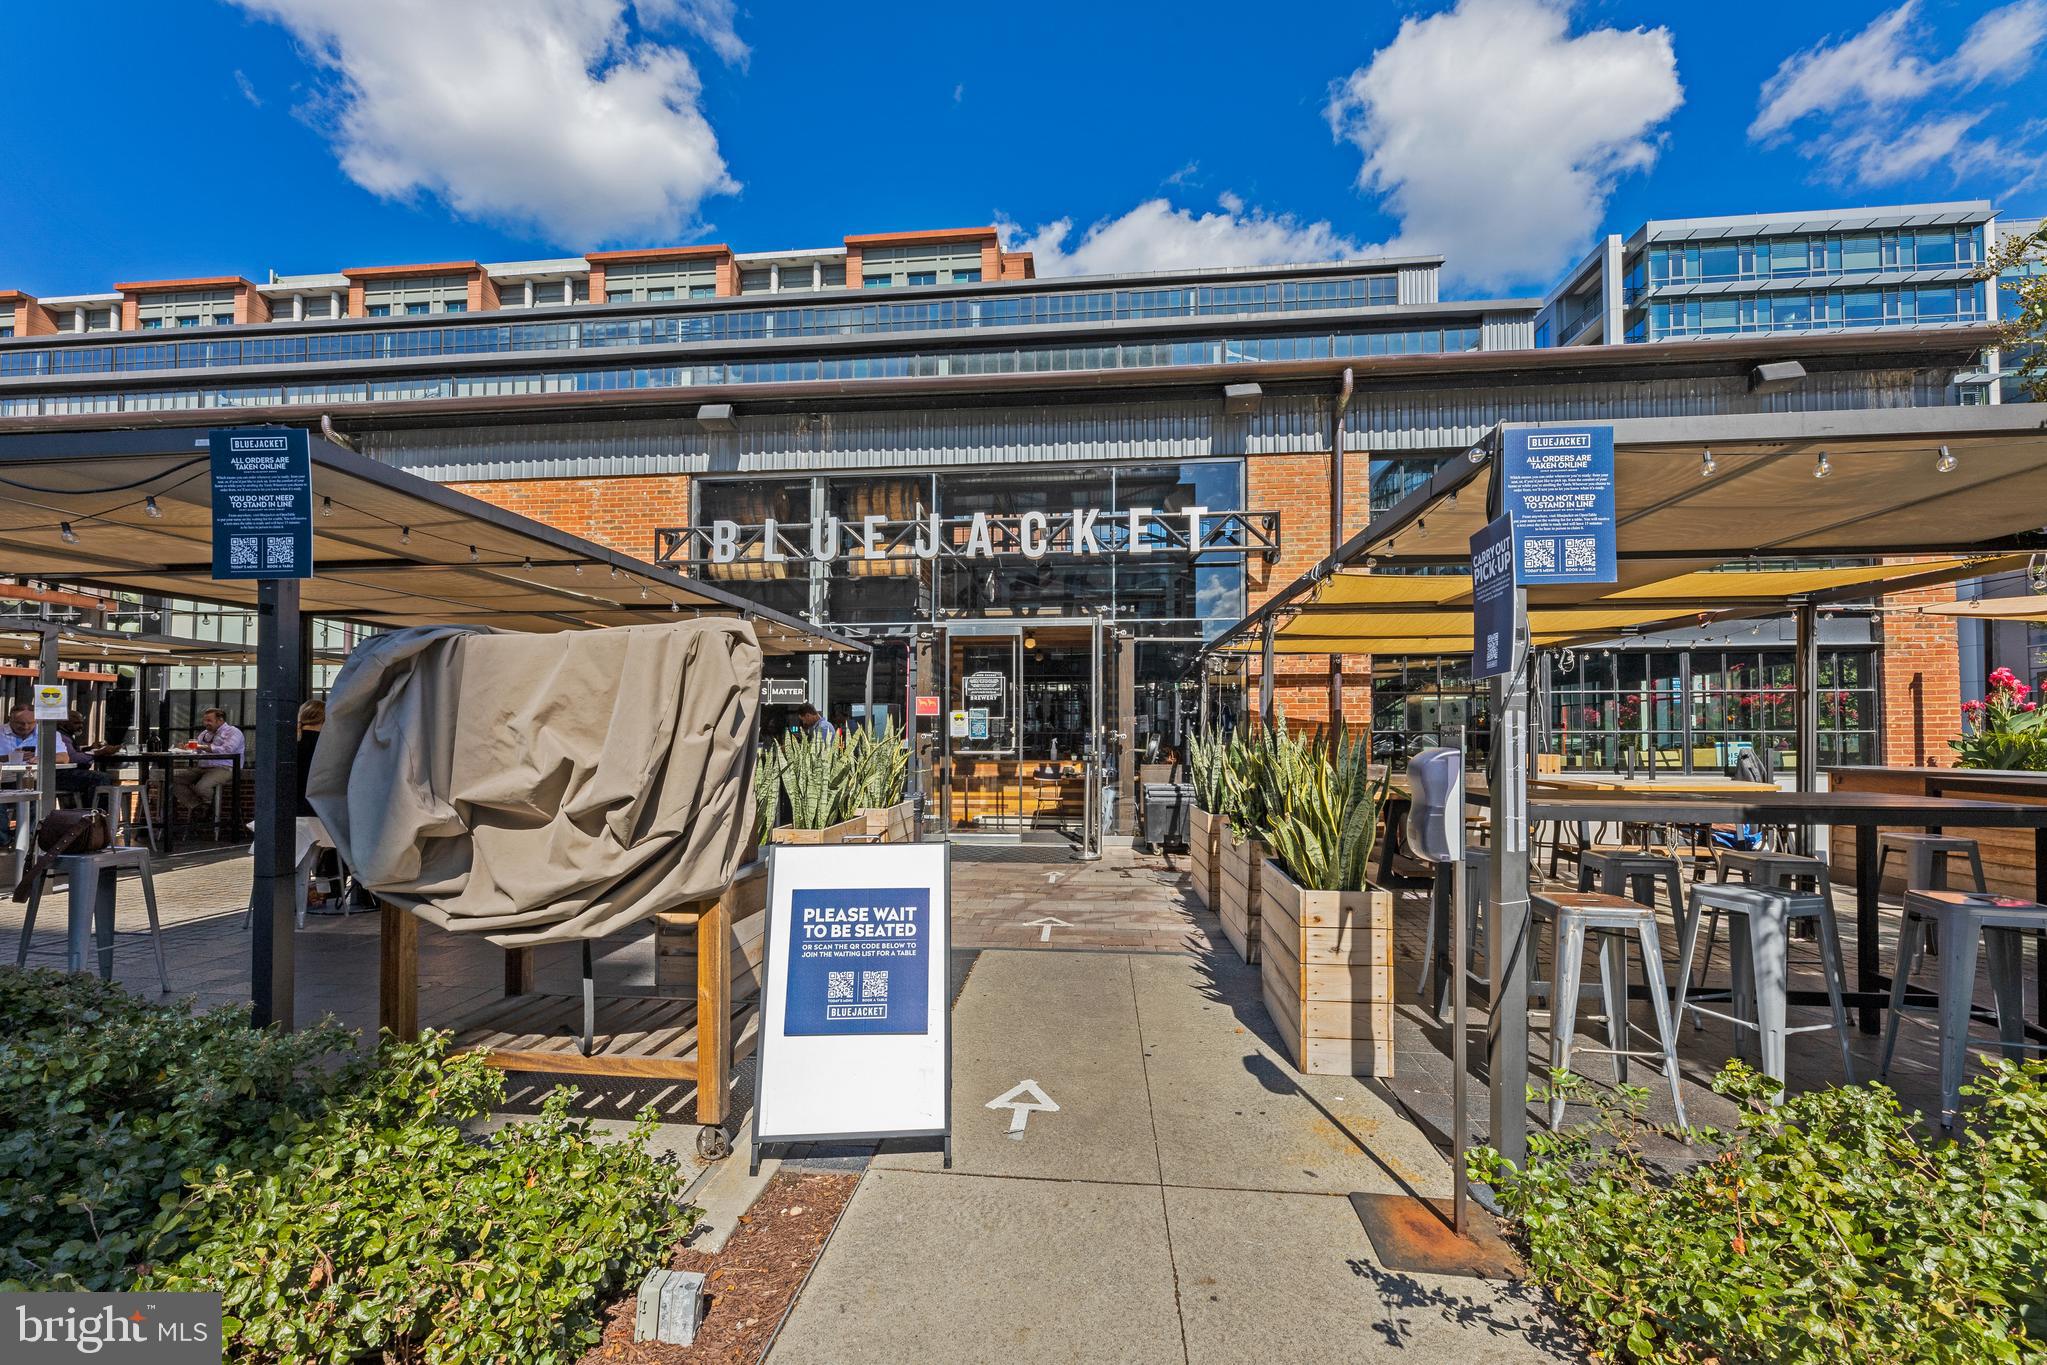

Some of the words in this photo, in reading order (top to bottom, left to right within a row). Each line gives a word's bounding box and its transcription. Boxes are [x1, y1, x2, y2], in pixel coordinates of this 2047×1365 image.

[234, 440, 284, 448] BLUEJACKET
[1532, 437, 1586, 446] BLUEJACKET
[713, 506, 1208, 563] BLUEJACKET
[1473, 545, 1494, 568] CARRY
[1495, 536, 1510, 556] OUT
[803, 908, 868, 922] PLEASE
[873, 906, 917, 921] WAIT
[803, 924, 827, 938] TO
[831, 924, 851, 938] BE
[854, 923, 916, 937] SEATED
[831, 1007, 883, 1017] BLUEJACKET
